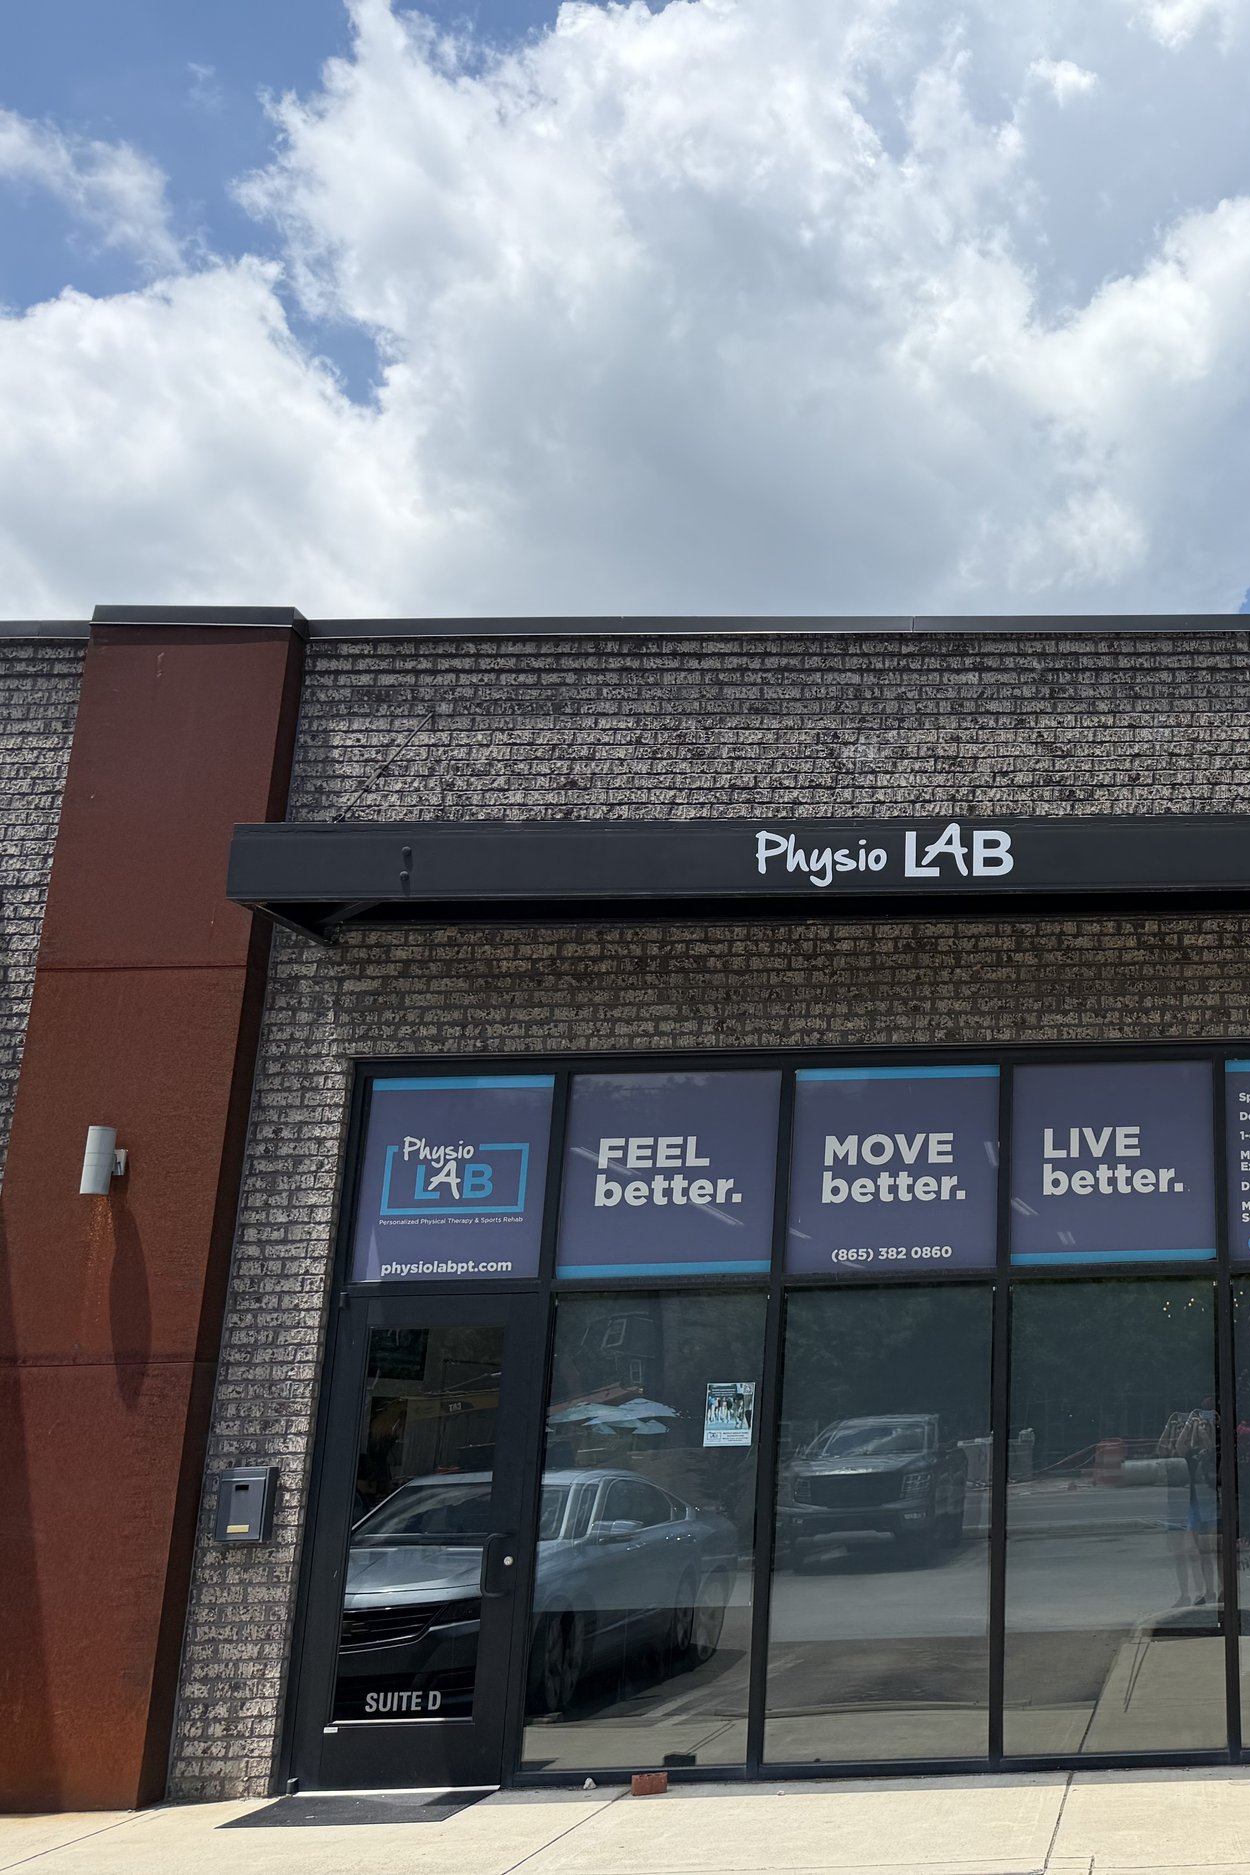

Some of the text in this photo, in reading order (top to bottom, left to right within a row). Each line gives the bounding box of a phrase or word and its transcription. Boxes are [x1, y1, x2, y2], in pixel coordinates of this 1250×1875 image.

[755, 823, 1014, 887] Physio LAB
[402, 1136, 474, 1168] Physio
[598, 1136, 710, 1169] FEEL
[823, 1133, 955, 1166] MOVE
[1043, 1126, 1140, 1159] LIVE
[414, 1160, 494, 1200] LAB
[594, 1174, 742, 1207] better.
[821, 1171, 967, 1204] better.
[1042, 1164, 1185, 1196] better.
[381, 1260, 512, 1276] physiolabpt.com
[831, 1245, 952, 1262] (865) 382 0860
[365, 1691, 441, 1712] SUITE D
